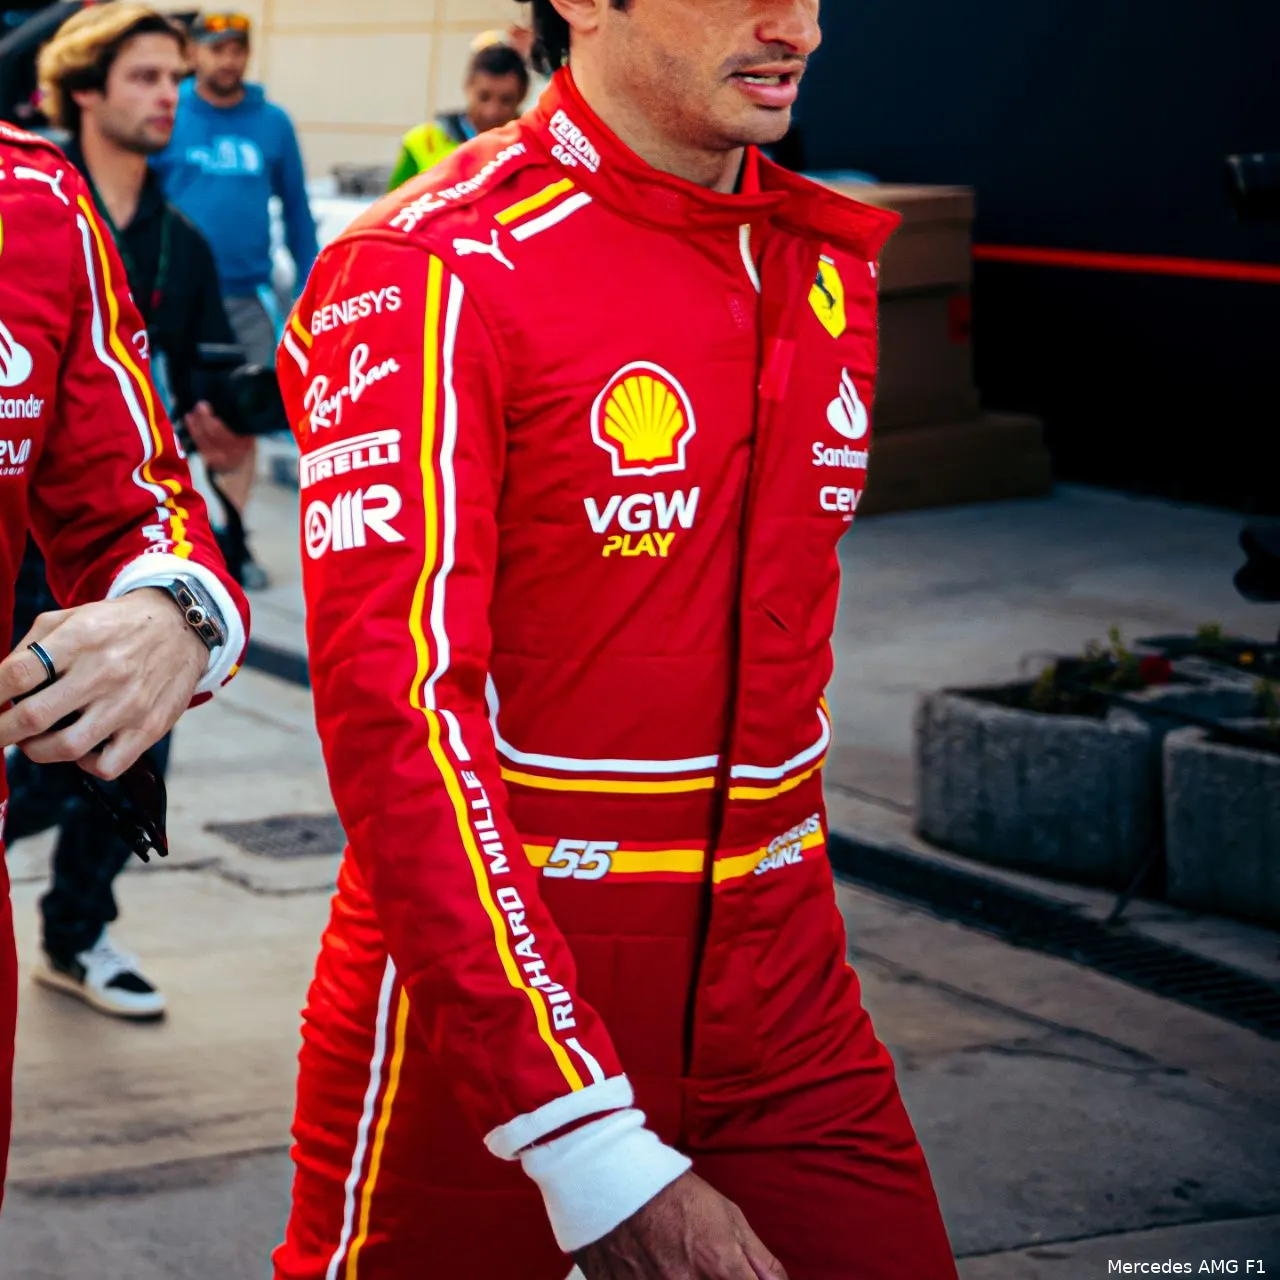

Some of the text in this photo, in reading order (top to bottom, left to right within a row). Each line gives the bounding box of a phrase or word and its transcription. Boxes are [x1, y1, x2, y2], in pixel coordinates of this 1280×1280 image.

[550, 109, 601, 168] PERONI
[311, 286, 402, 336] GENESYS
[300, 429, 402, 489] PIRELLI
[583, 486, 701, 534] VGW
[602, 532, 677, 558] PLAY
[542, 838, 619, 880] 55
[461, 770, 578, 1031] RICHARD MILLE
